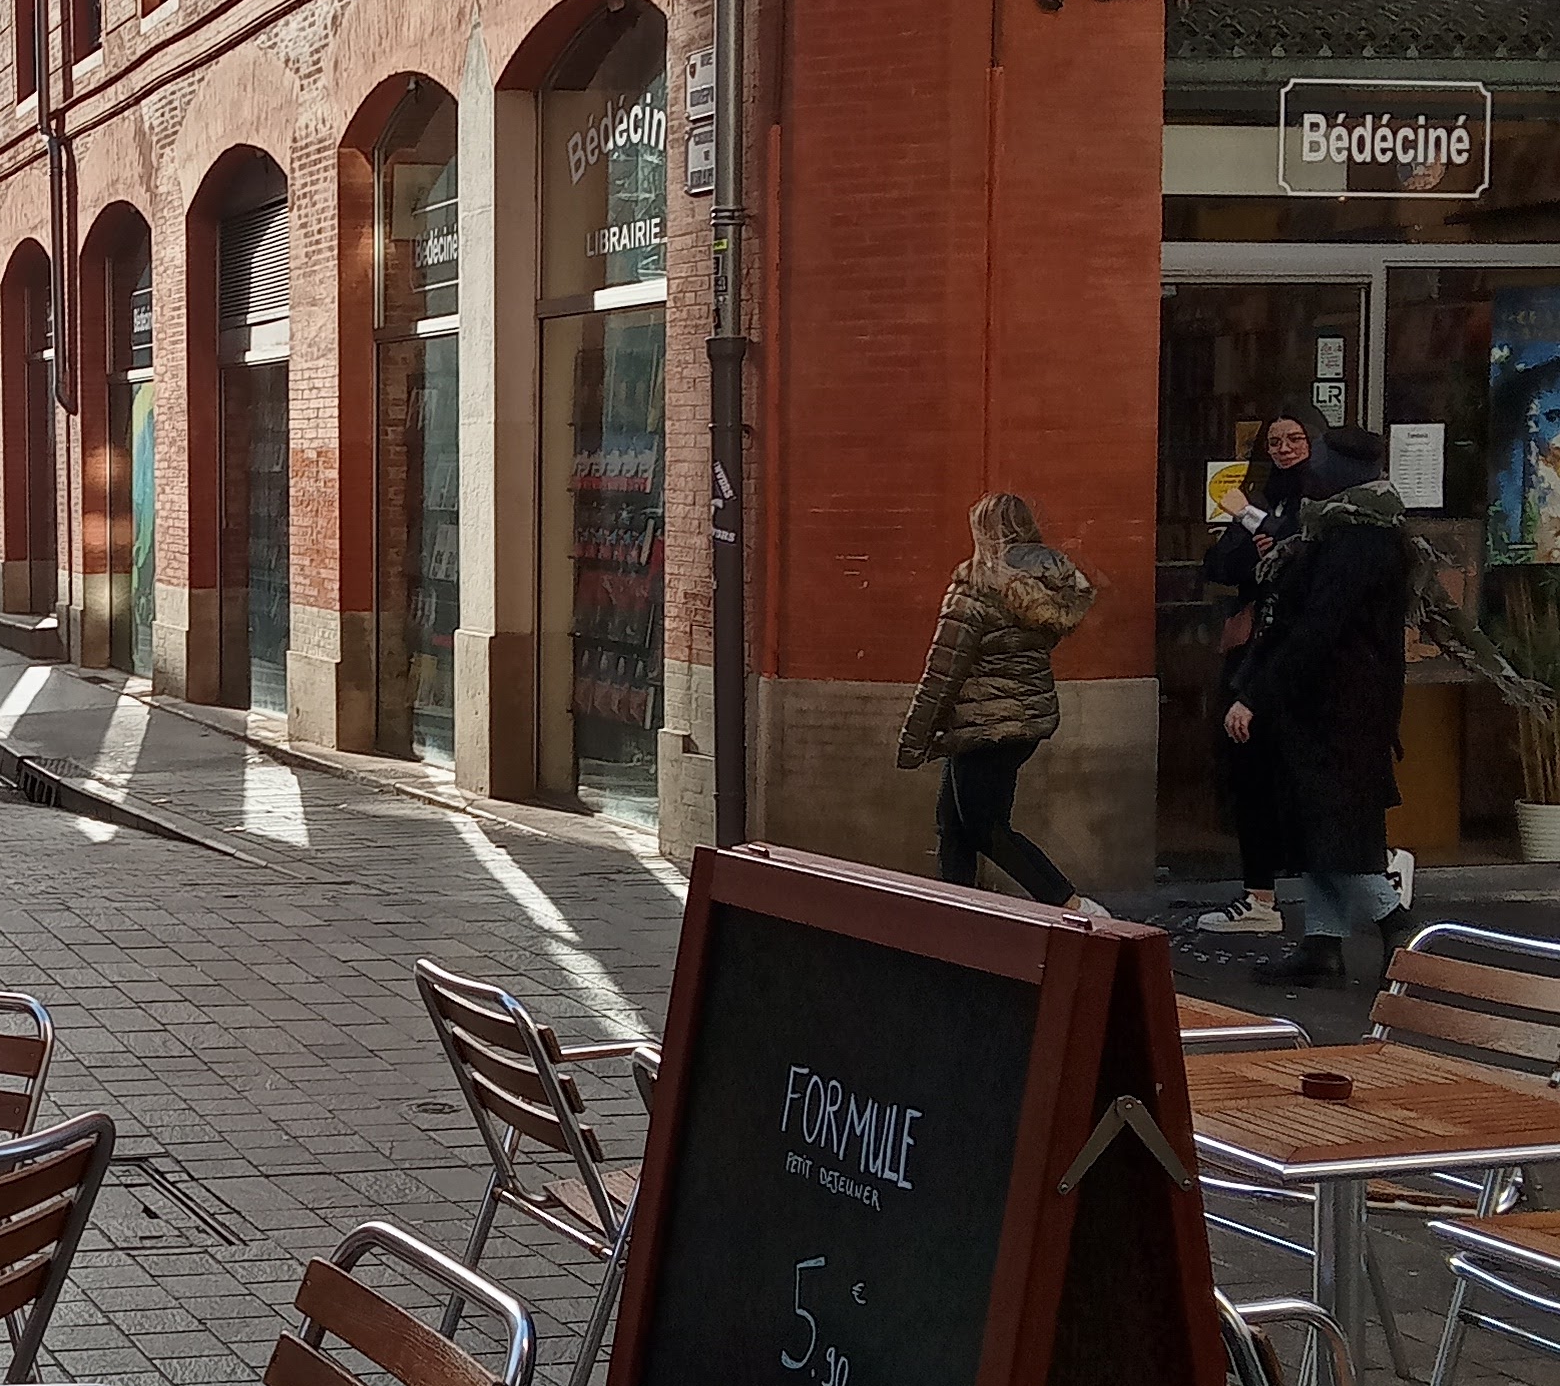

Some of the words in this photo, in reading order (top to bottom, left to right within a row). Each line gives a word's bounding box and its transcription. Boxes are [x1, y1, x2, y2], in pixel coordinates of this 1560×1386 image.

[1302, 112, 1471, 164] Bédéciné
[415, 223, 458, 268] Bédéciné
[585, 217, 662, 258] LIBRAIRIE
[781, 1065, 923, 1190] FORMULE
[819, 1167, 881, 1212] DEJEUNER
[851, 1282, 867, 1305] €
